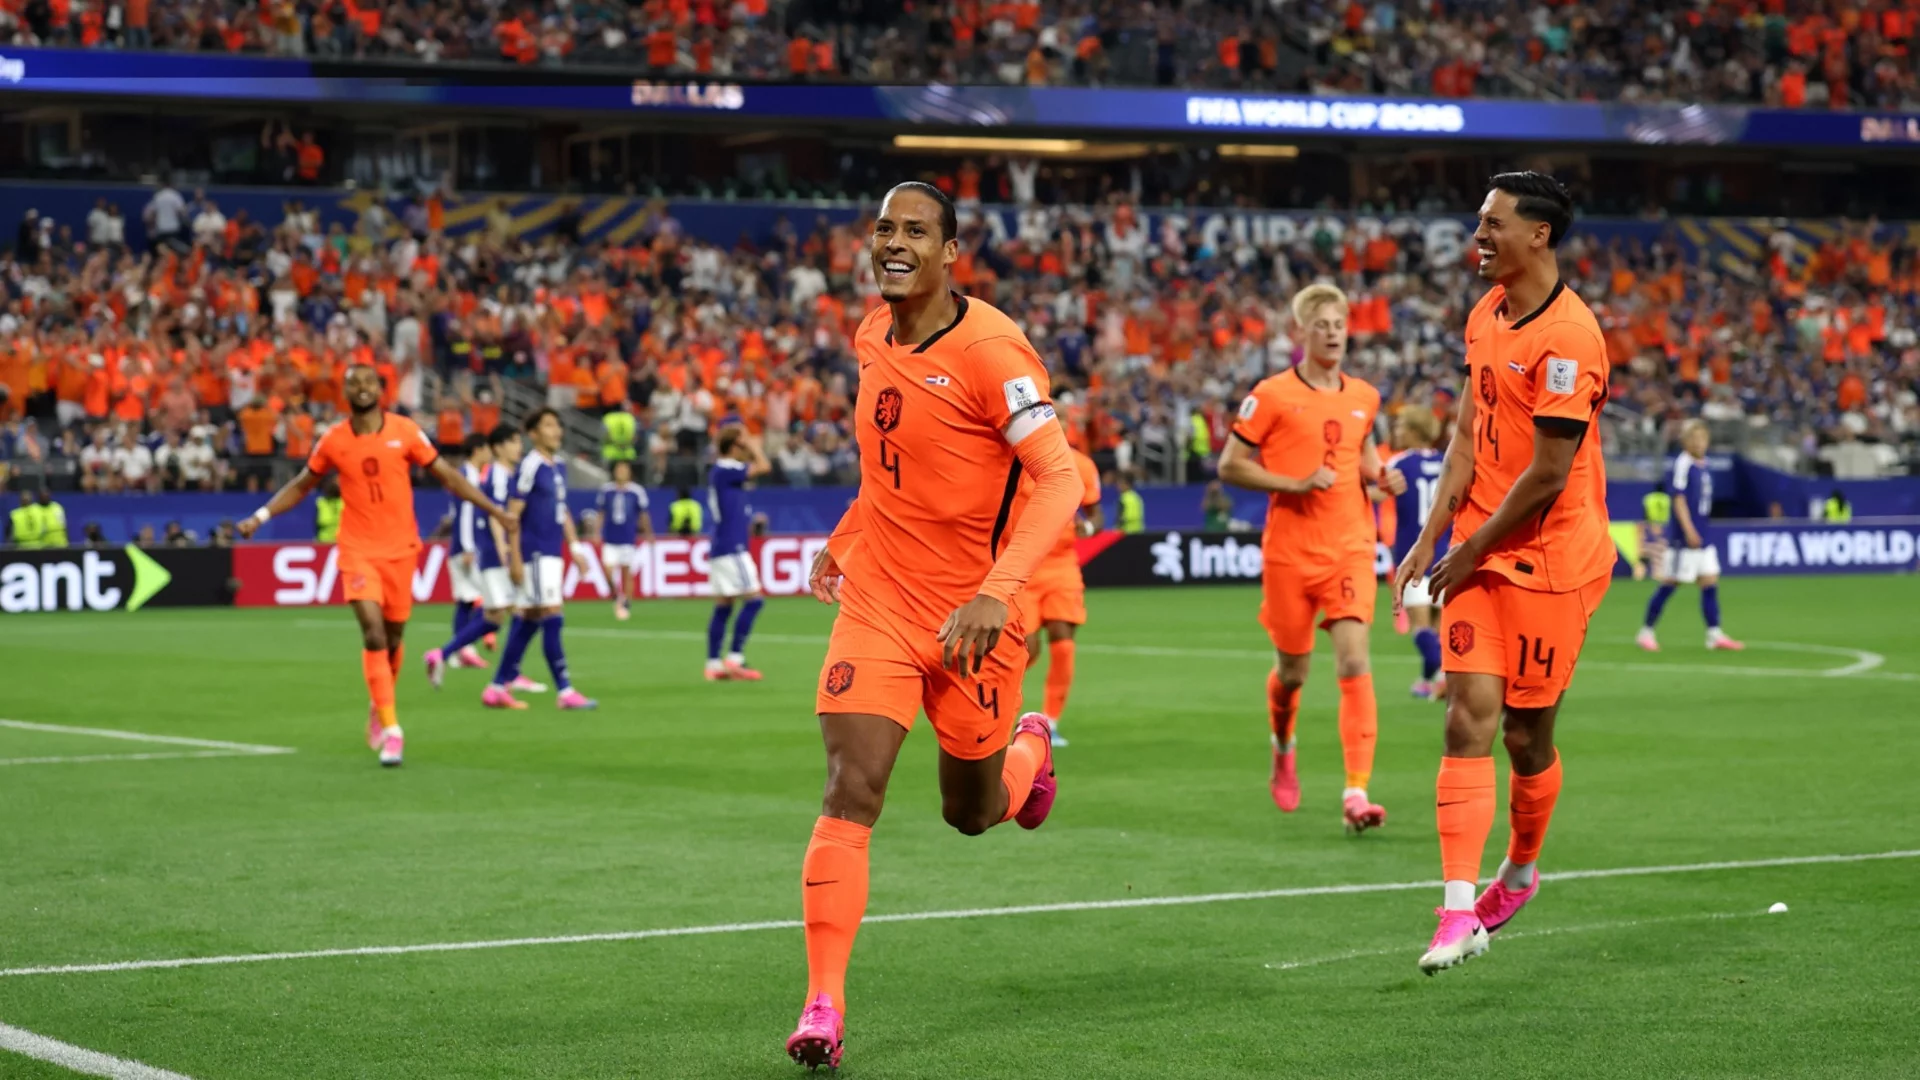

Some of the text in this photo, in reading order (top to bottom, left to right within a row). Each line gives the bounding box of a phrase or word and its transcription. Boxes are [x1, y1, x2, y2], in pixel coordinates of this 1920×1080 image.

[1187, 97, 1241, 125] FIFA
[1242, 98, 1329, 128] WORLD
[1330, 101, 1378, 129] CUP
[881, 439, 900, 489] 4
[1728, 532, 1799, 567] FIFA
[1800, 530, 1915, 565] WORLD
[1518, 633, 1556, 678] 14
[977, 682, 999, 720] 4
